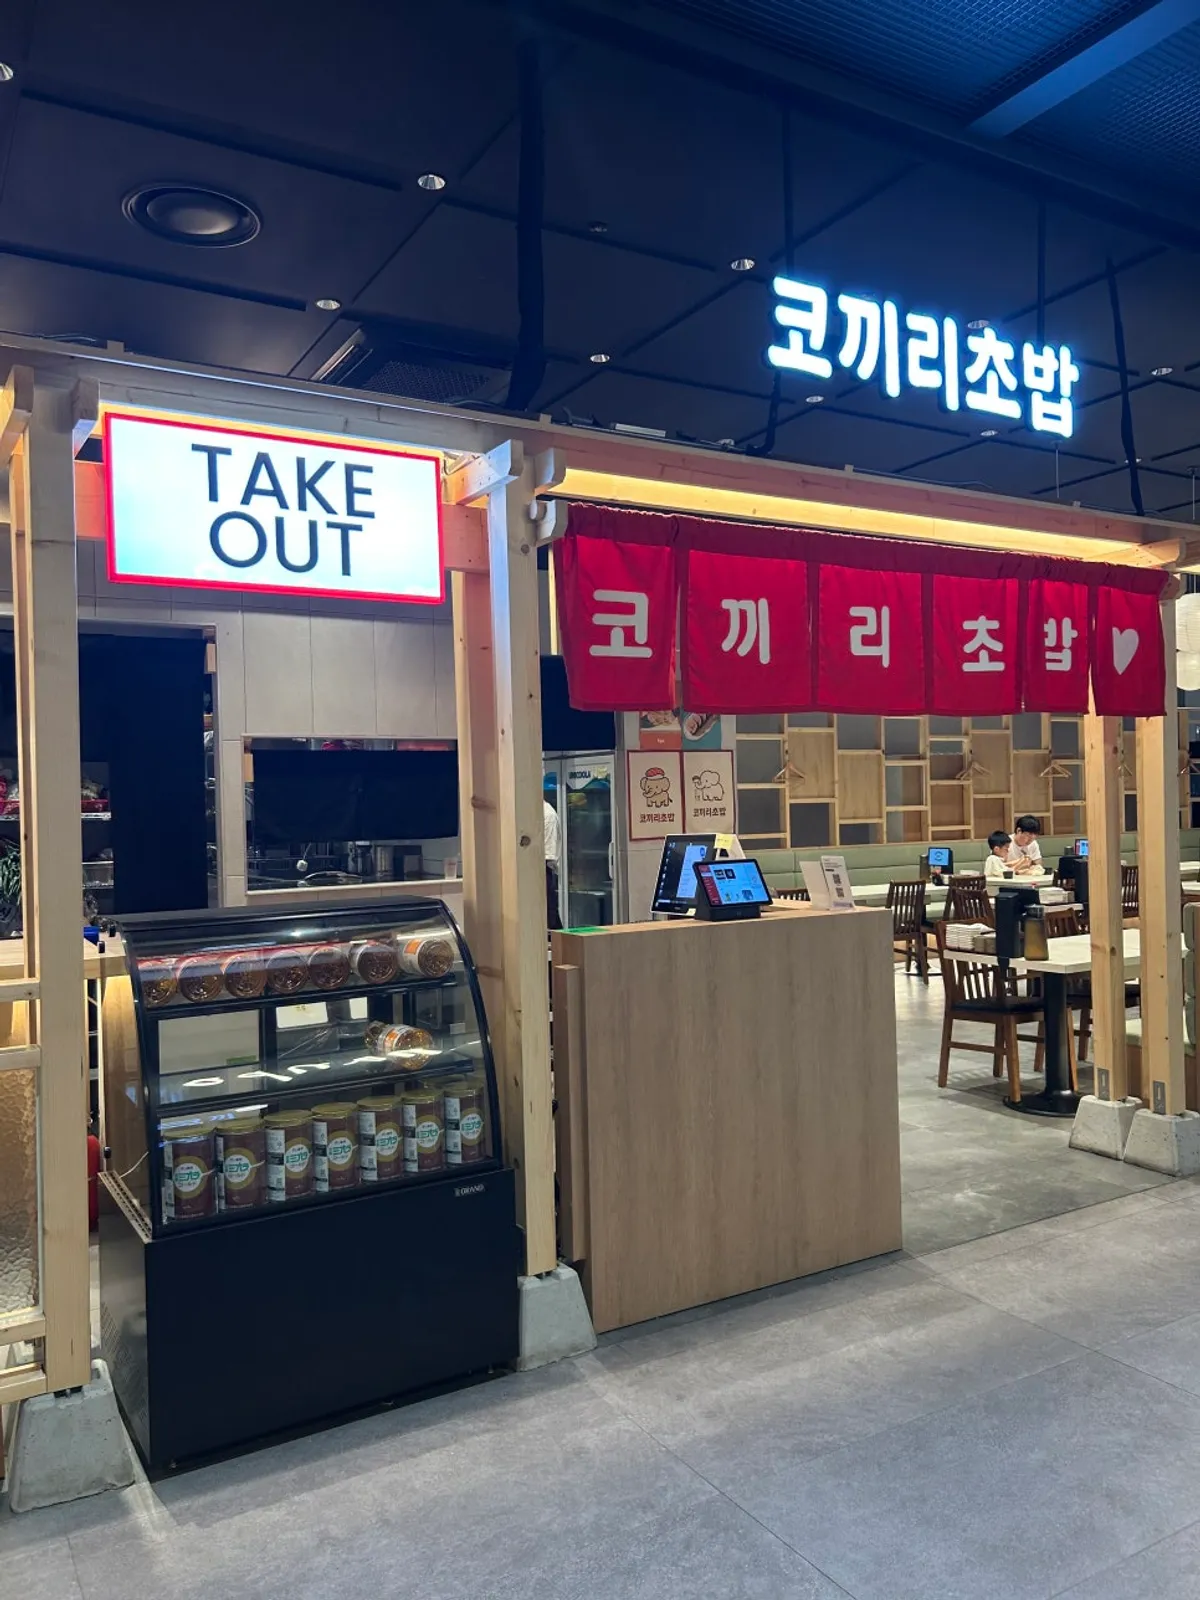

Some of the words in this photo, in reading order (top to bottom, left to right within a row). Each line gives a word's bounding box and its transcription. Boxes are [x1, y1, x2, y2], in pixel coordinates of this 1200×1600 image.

[767, 275, 1080, 438] 코끼리초밥
[191, 443, 376, 519] TAKE
[209, 510, 363, 577] OUT
[639, 813, 675, 824] 코끼리초밥
[693, 807, 727, 818] 코끼리초밥
